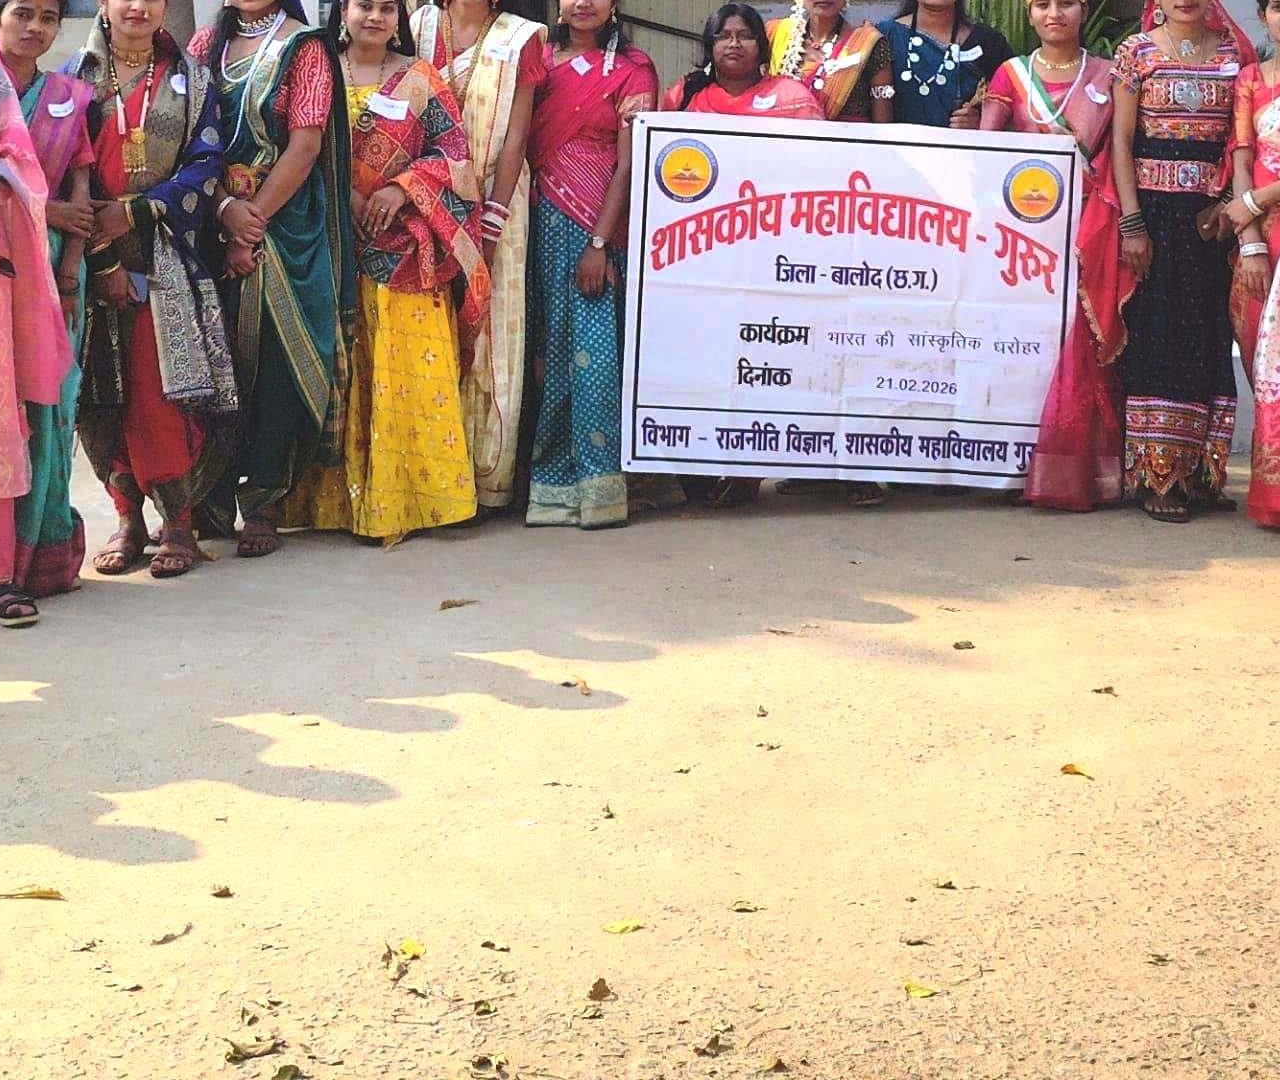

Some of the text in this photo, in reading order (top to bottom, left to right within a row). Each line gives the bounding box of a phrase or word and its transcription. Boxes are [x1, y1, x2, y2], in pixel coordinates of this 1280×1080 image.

[649, 180, 788, 272] शासकीय
[790, 170, 971, 253] महाविद्यालय
[994, 220, 1059, 295] गुरुर
[775, 254, 816, 285] जिला
[831, 259, 883, 289] बालोद
[739, 316, 1041, 355] कार्यक्रम भारत की सांस्कृतिक धरोहर
[737, 357, 958, 396] दिनांक 21.02.2026
[642, 416, 690, 448] विभाग
[716, 421, 780, 453] राजनीति
[785, 422, 838, 457] विज्ञान,
[844, 426, 912, 458] शासकीय
[918, 429, 1008, 464] महाविद्यालय
